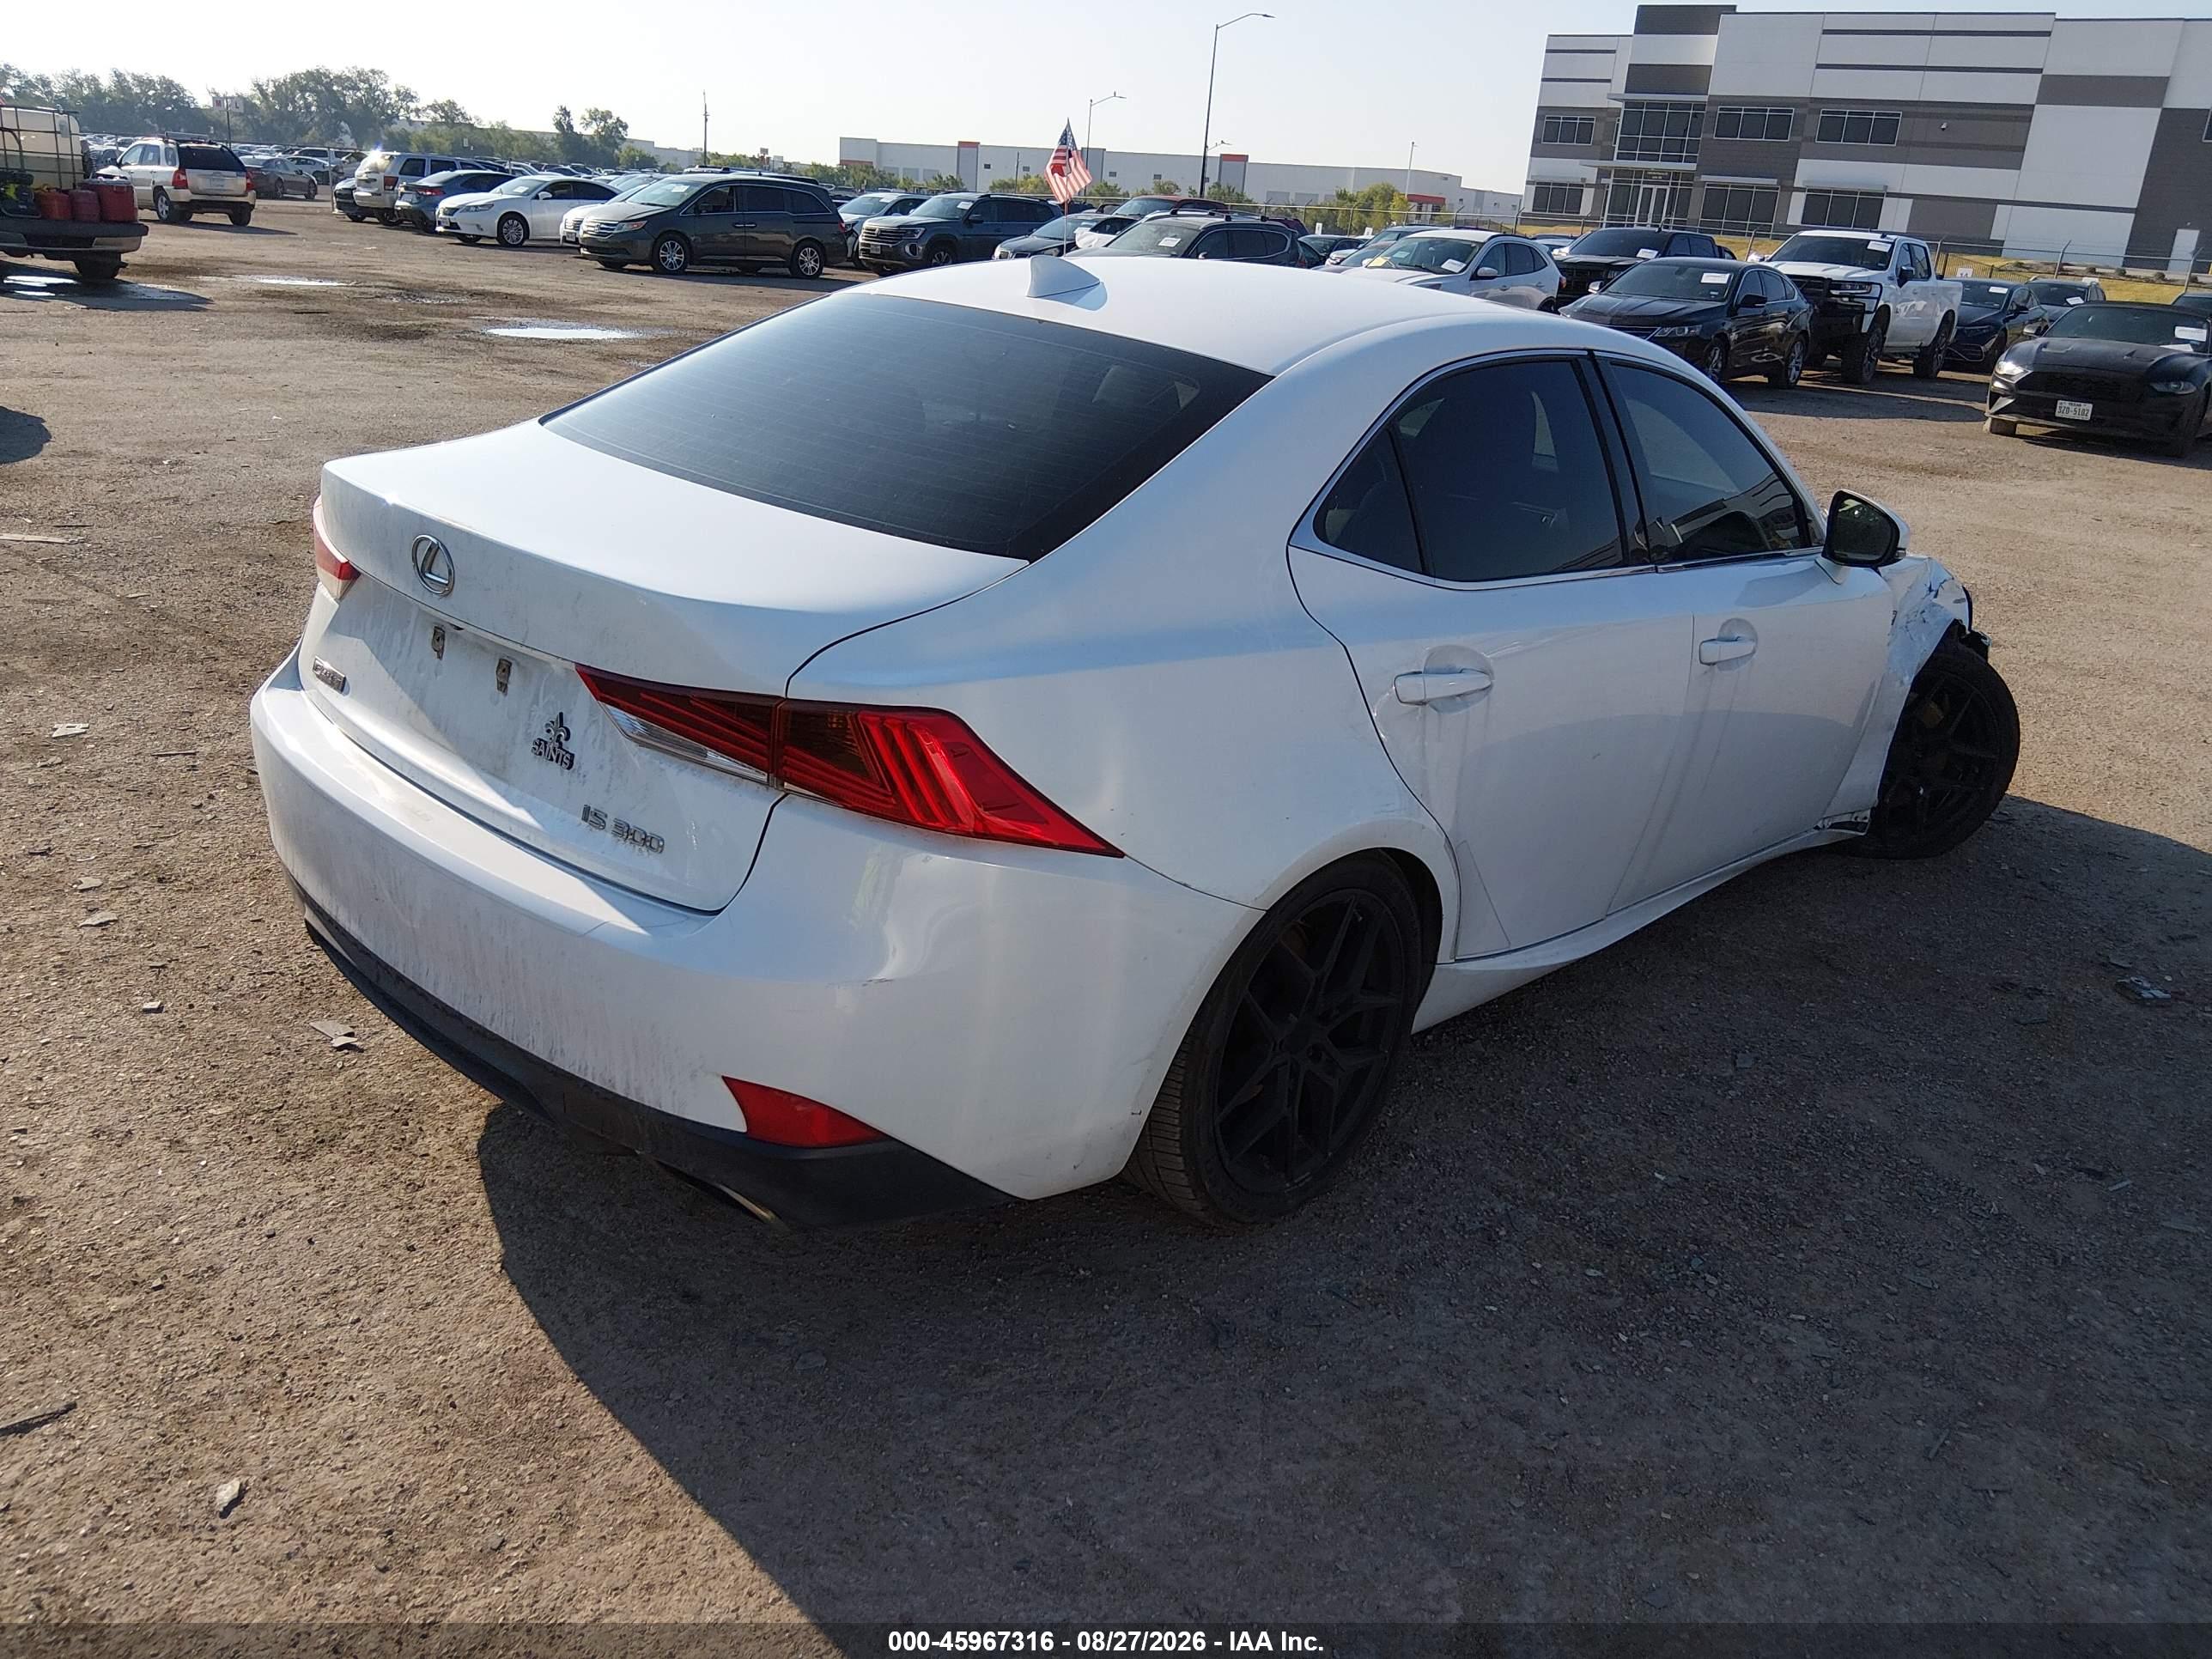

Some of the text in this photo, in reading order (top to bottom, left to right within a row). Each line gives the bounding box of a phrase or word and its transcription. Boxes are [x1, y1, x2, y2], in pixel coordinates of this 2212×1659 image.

[532, 738, 574, 770] SAINTS
[581, 805, 665, 854] IS 300
